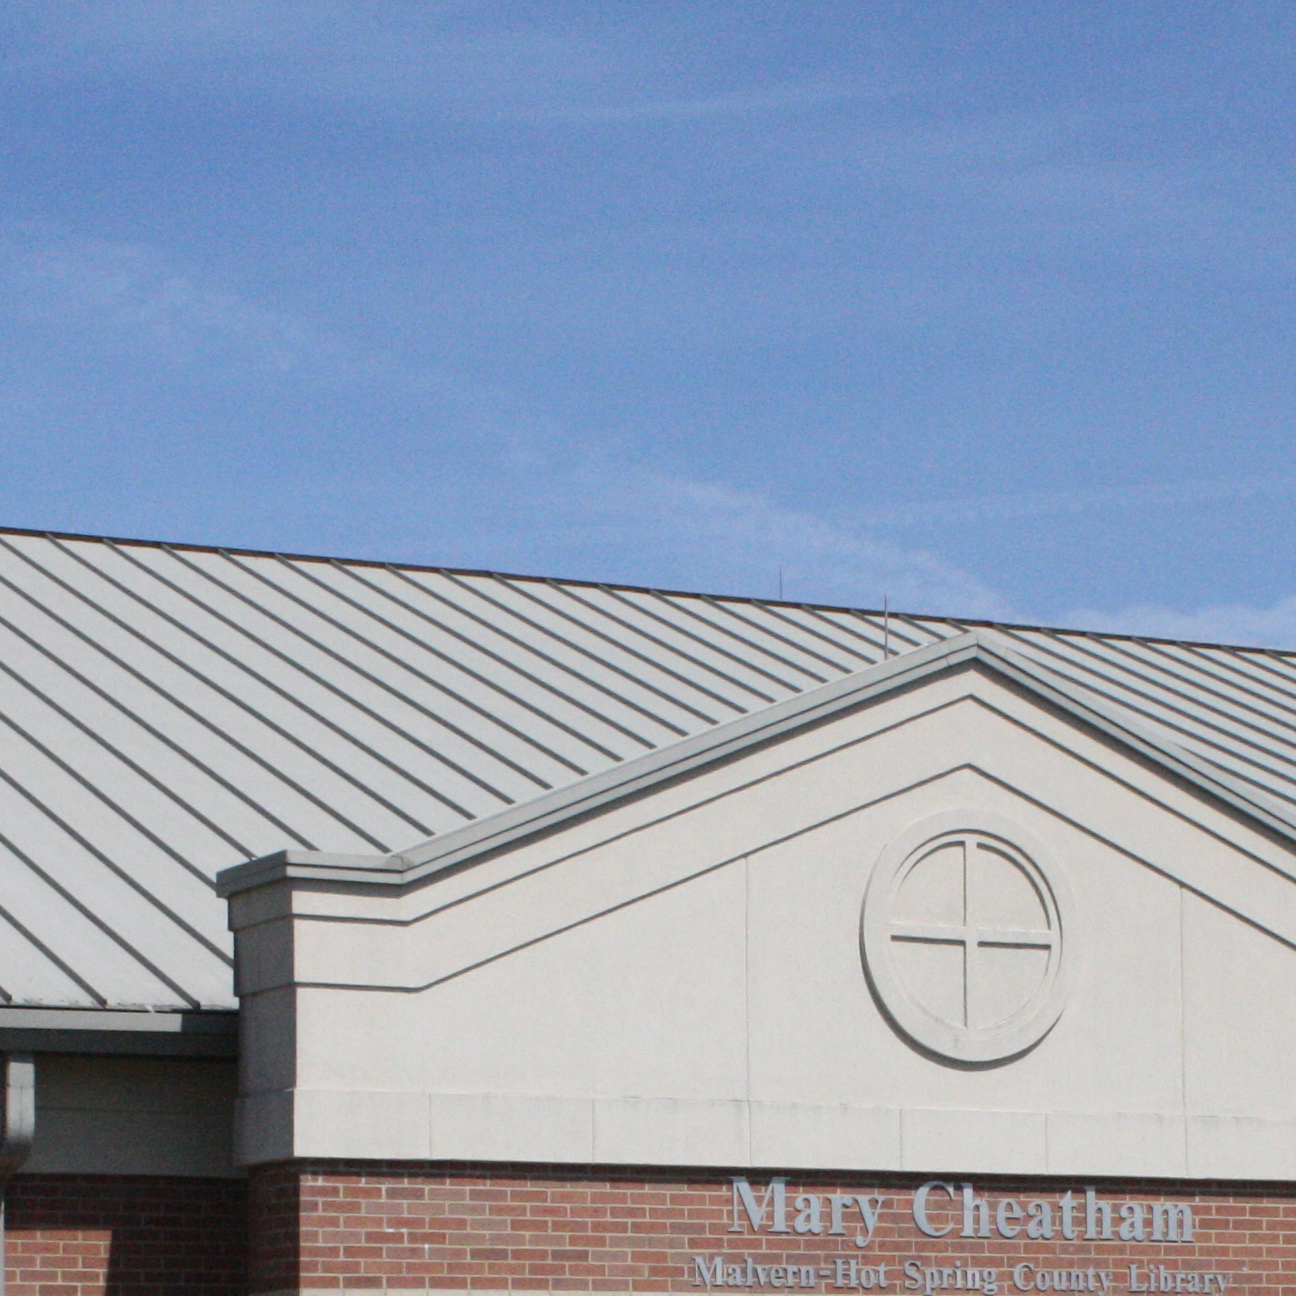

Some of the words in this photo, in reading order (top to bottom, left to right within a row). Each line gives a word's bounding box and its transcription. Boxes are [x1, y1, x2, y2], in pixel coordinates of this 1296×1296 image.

[727, 1176, 885, 1247] Mary
[912, 1181, 1194, 1243] Cheatham
[692, 1256, 888, 1289] Malvern-Hot
[903, 1261, 999, 1296] Spring
